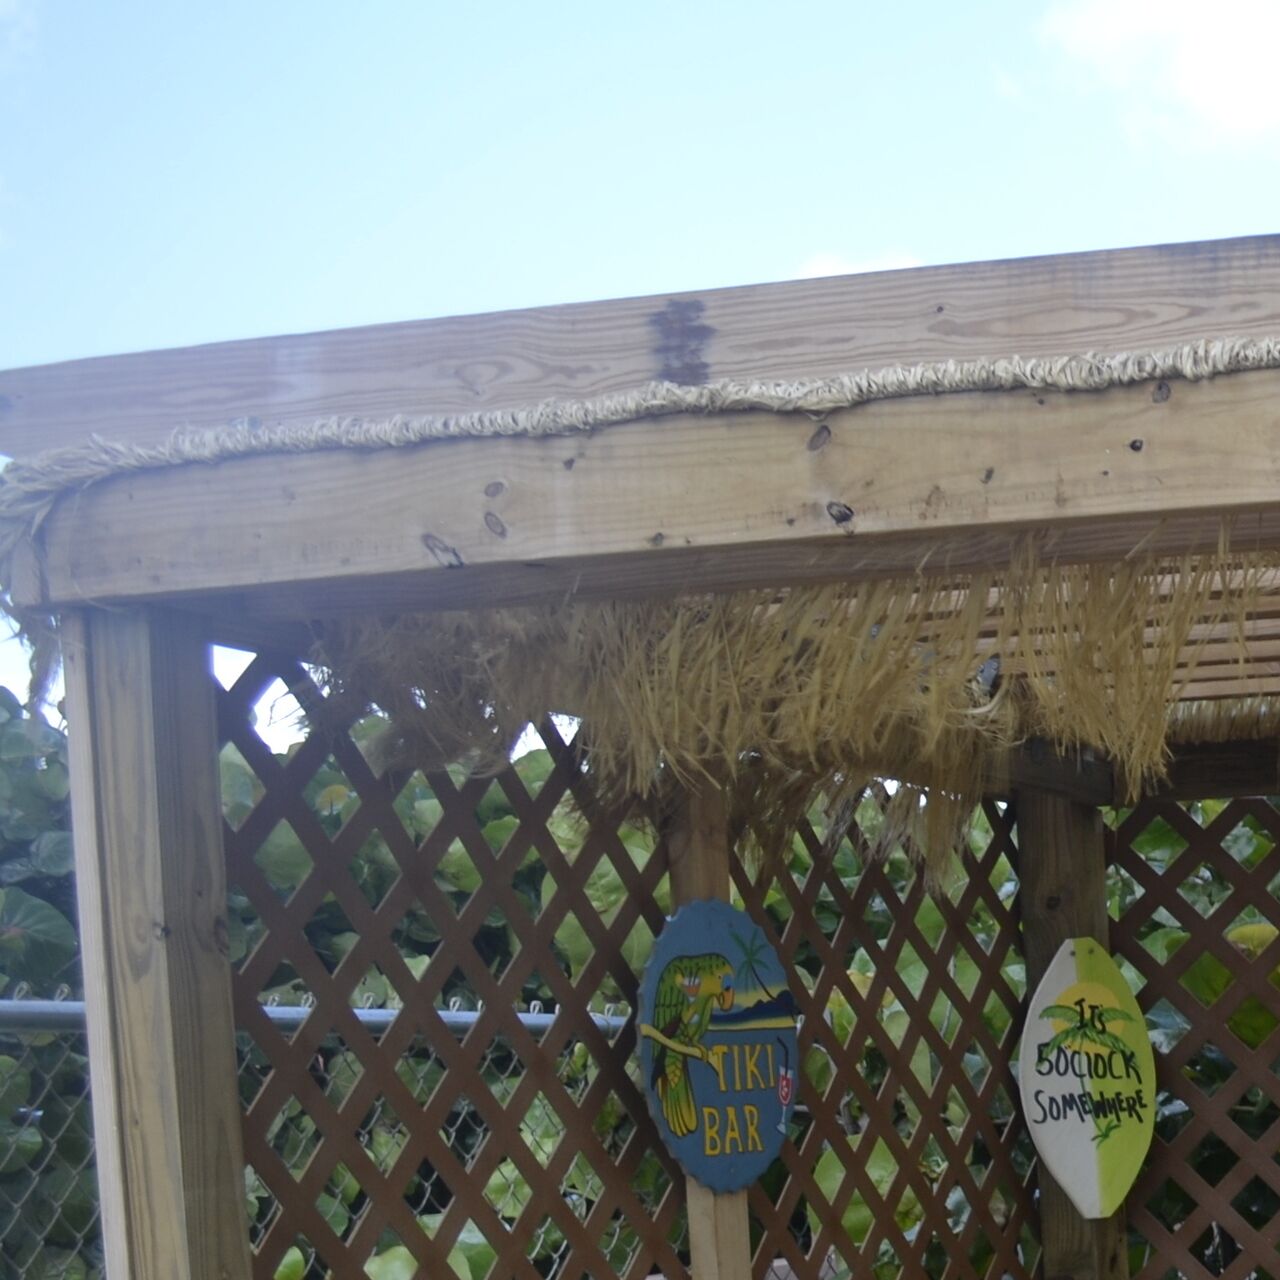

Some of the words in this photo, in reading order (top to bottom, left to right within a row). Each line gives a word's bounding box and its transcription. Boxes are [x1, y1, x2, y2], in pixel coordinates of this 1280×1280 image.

[711, 1043, 776, 1092] TIKI
[701, 1104, 764, 1157] BAR
[1031, 1089, 1148, 1125] SOMEWHERE
